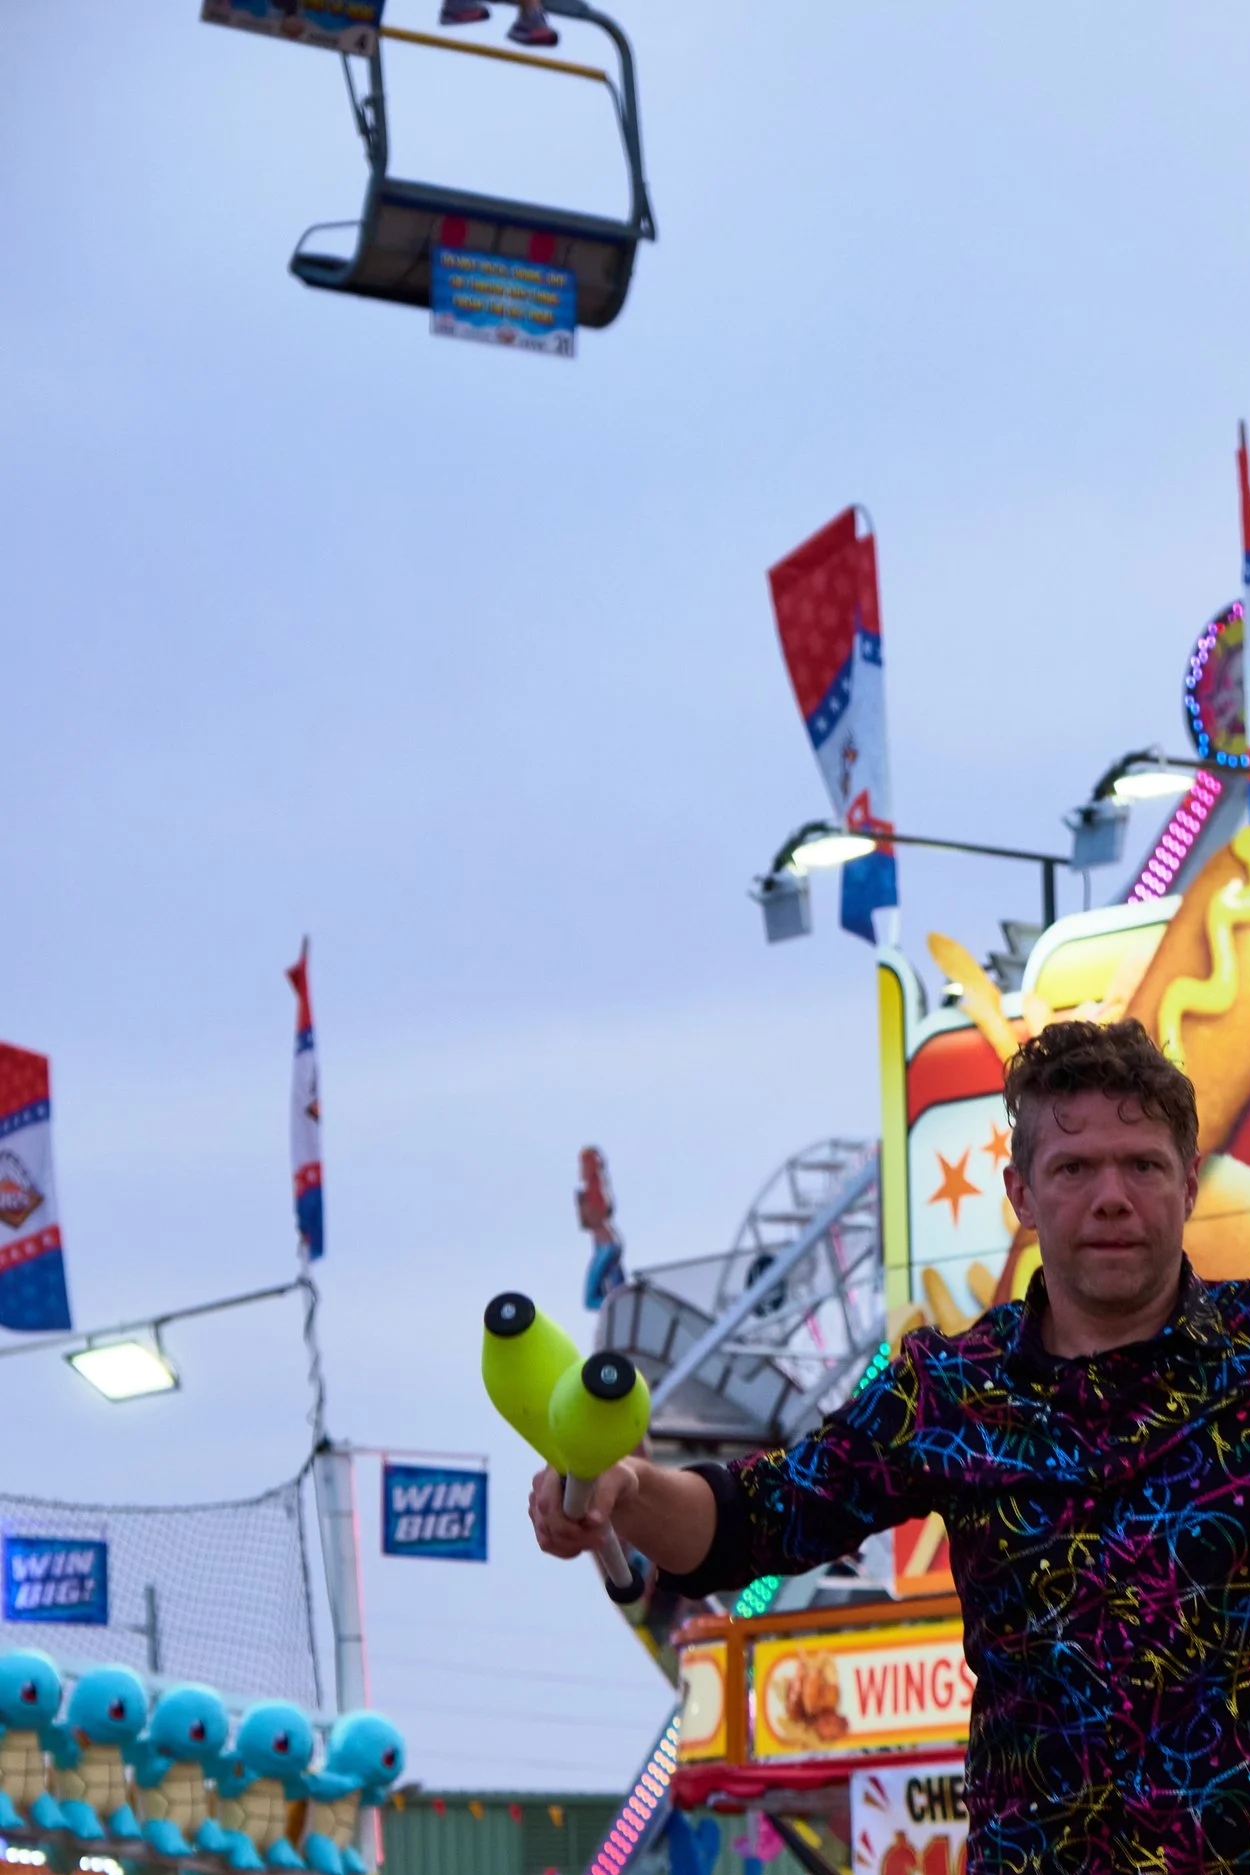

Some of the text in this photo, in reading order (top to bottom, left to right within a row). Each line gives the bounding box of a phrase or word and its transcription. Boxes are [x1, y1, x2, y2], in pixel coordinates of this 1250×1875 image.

[392, 1481, 477, 1512] WIN
[395, 1511, 477, 1542] BIG!
[11, 1549, 95, 1582] WIN
[14, 1579, 95, 1610] BIG!
[855, 1657, 976, 1718] WINGS
